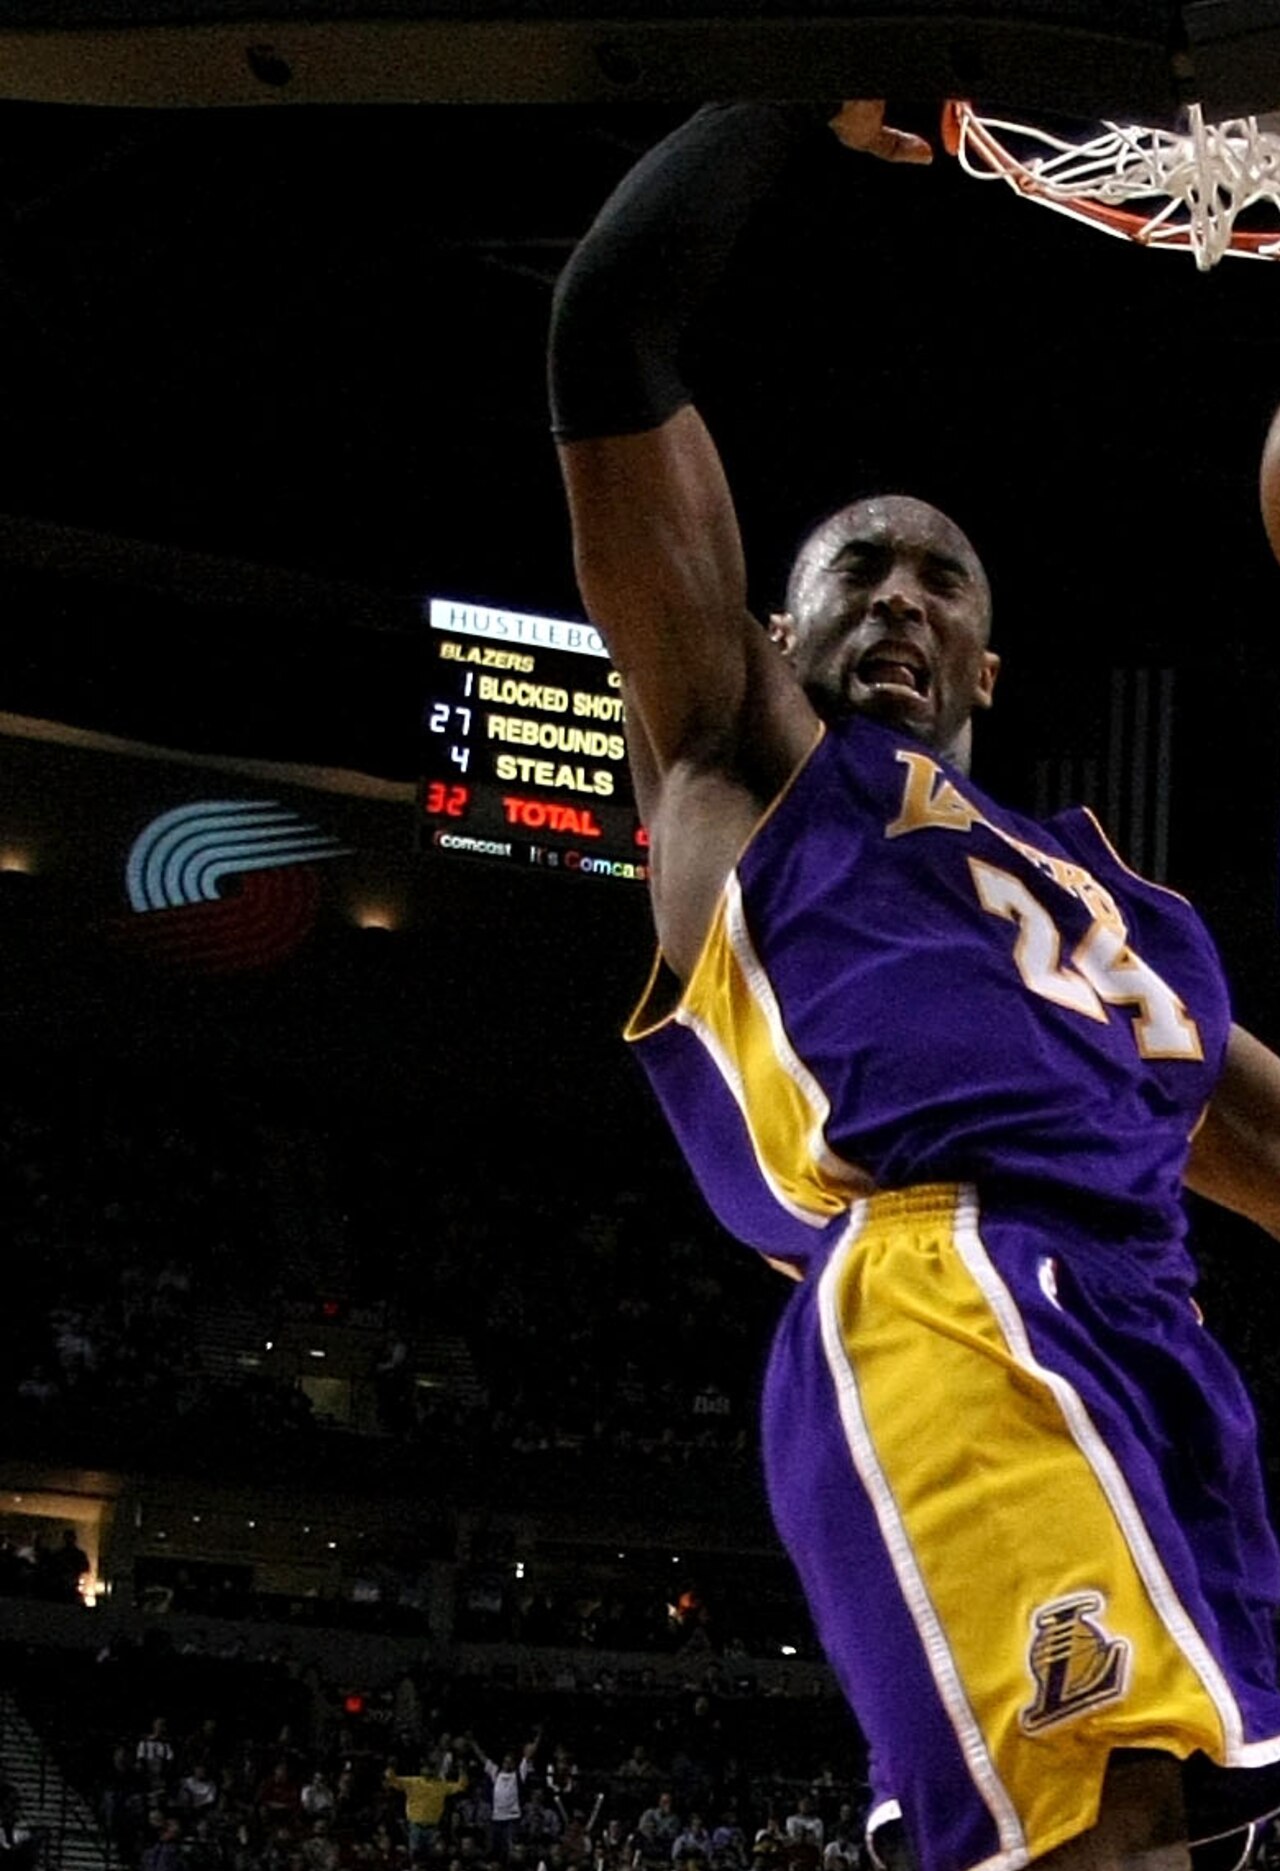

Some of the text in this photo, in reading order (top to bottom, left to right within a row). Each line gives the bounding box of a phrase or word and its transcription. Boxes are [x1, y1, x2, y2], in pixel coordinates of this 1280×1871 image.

[440, 641, 534, 672] BLAZERS
[464, 672, 626, 723] 1 BLOCKED SHOT
[430, 703, 625, 760] 27 REBOUNDS
[451, 746, 615, 795] 4 STEALS
[427, 783, 468, 816] 32
[503, 796, 601, 836] TOTAL
[966, 855, 1204, 1062] 24
